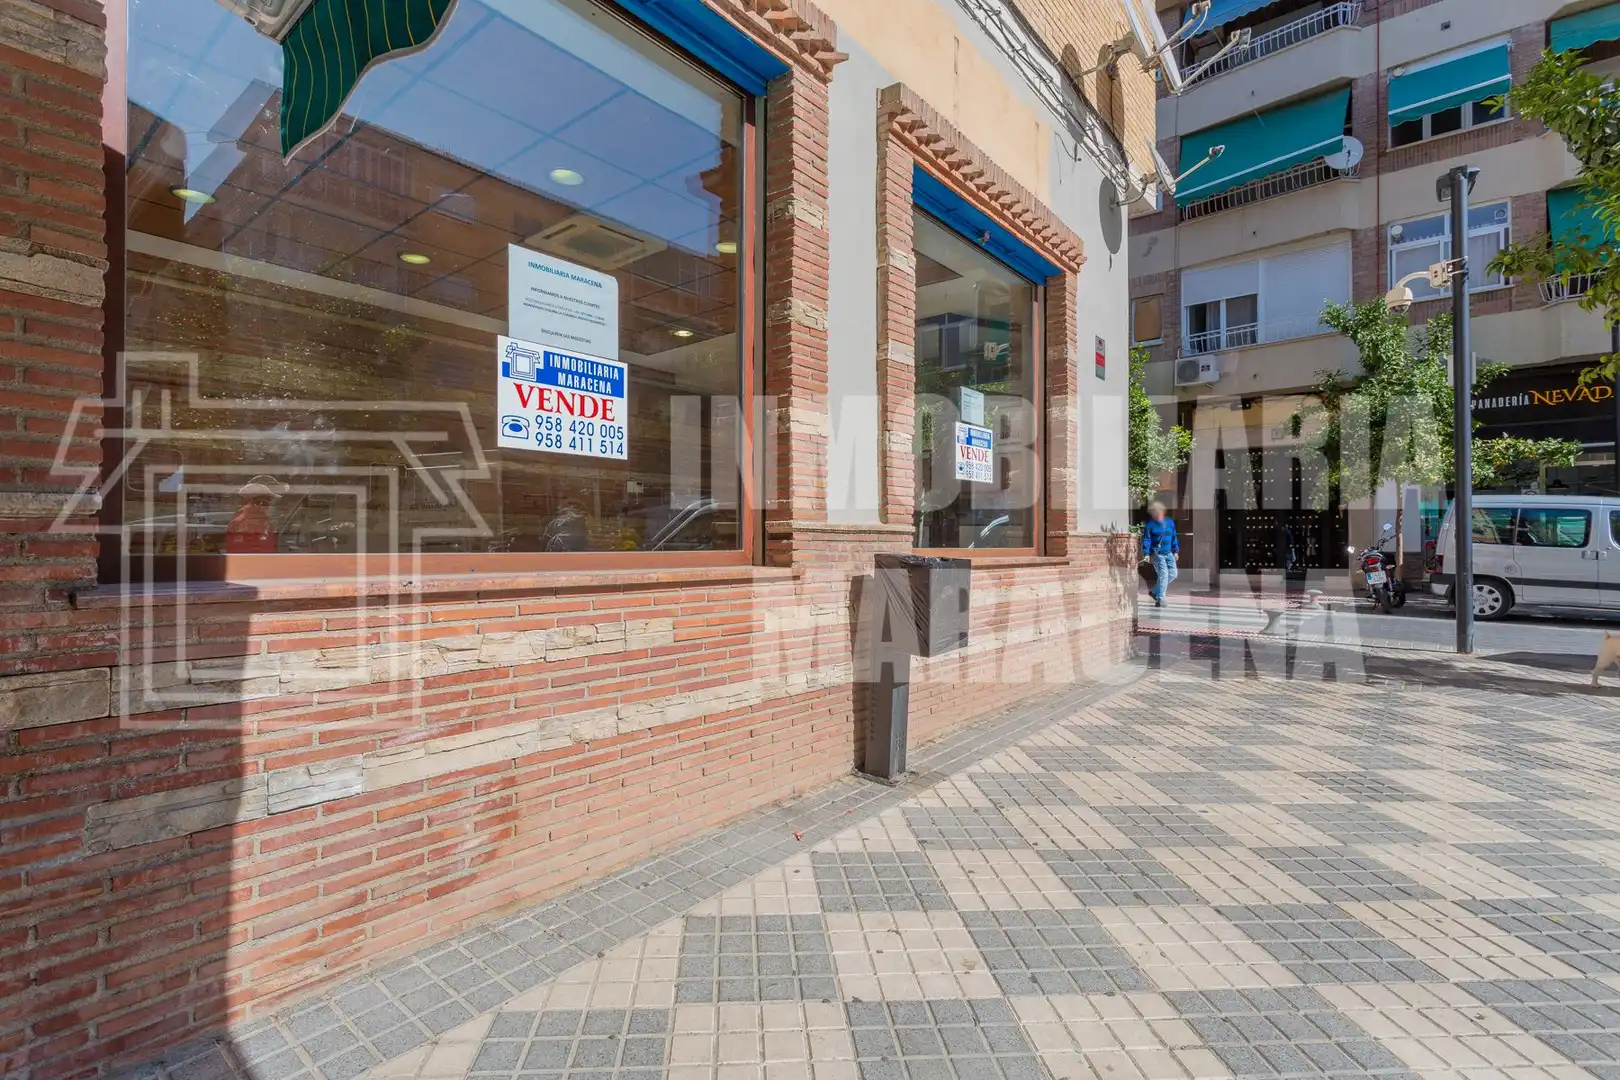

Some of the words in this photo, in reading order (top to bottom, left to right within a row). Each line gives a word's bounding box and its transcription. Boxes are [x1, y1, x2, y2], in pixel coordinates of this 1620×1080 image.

[528, 261, 570, 278] INMOBILIARIA
[571, 274, 603, 289] MARACENA
[550, 354, 619, 381] INMOBILIARIA
[557, 372, 612, 395] MARACENA
[513, 382, 616, 422] VENDE
[1471, 393, 1530, 410] PANADERÍA
[1528, 384, 1614, 406] NEVAD
[535, 414, 563, 433] 958
[568, 420, 595, 437] 420
[600, 424, 624, 441] 005
[535, 431, 563, 449] 958
[568, 437, 592, 452] 411
[600, 440, 624, 456] 514
[960, 445, 989, 463] VENDE
